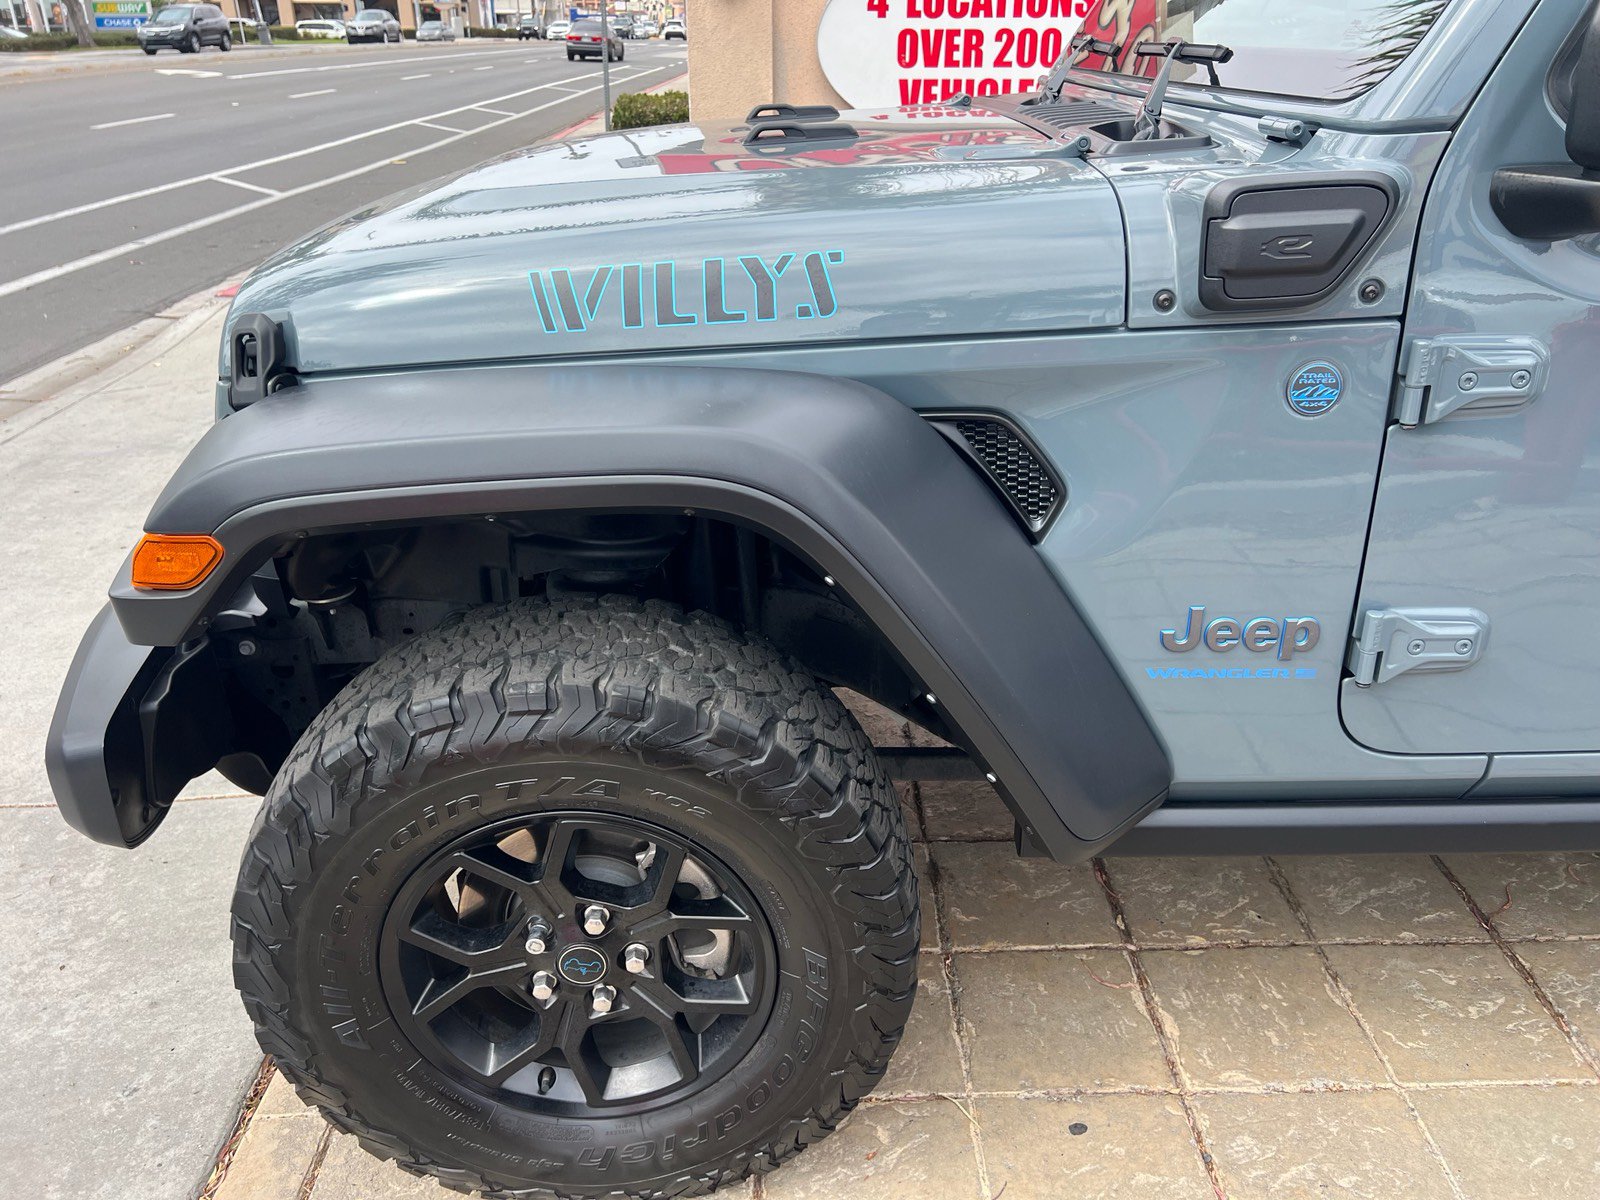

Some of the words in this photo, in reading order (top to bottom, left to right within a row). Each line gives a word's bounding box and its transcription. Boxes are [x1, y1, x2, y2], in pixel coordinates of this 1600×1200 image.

[96, 3, 143, 13] SUBWAY
[104, 18, 132, 27] CHASE
[897, 28, 984, 69] OVER
[993, 28, 1062, 68] 200
[898, 78, 1041, 106] VEHIC
[528, 250, 845, 333] WILLYS
[1160, 606, 1320, 661] Jeep
[1145, 667, 1290, 680] WRANGLER
